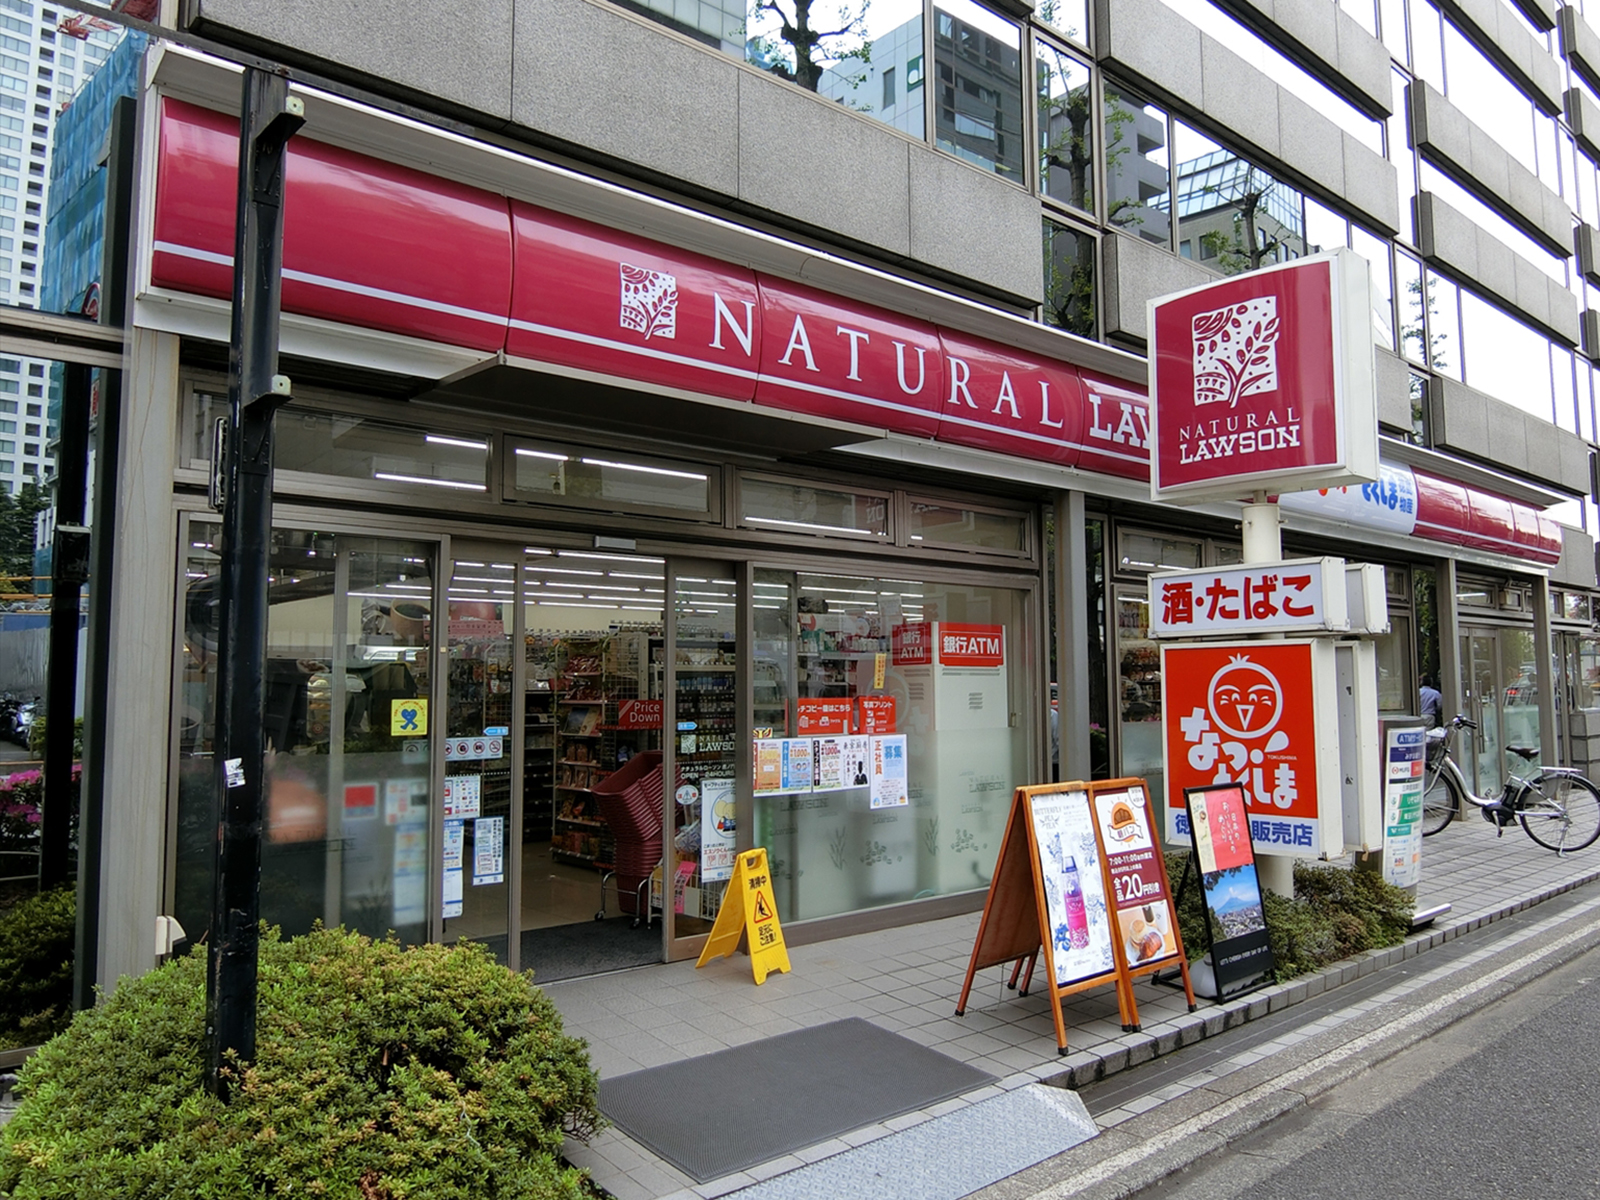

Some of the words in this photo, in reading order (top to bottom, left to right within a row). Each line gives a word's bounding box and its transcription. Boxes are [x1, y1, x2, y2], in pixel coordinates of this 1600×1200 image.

[709, 291, 1064, 429] NATURAL
[1179, 407, 1300, 441] NATURAL
[1179, 424, 1300, 464] LAWSON
[1161, 574, 1314, 625] 酒・たばこ
[901, 646, 924, 658] ATM
[943, 635, 1000, 655] 銀行ATM
[629, 711, 660, 724] Down
[634, 701, 660, 713] Price
